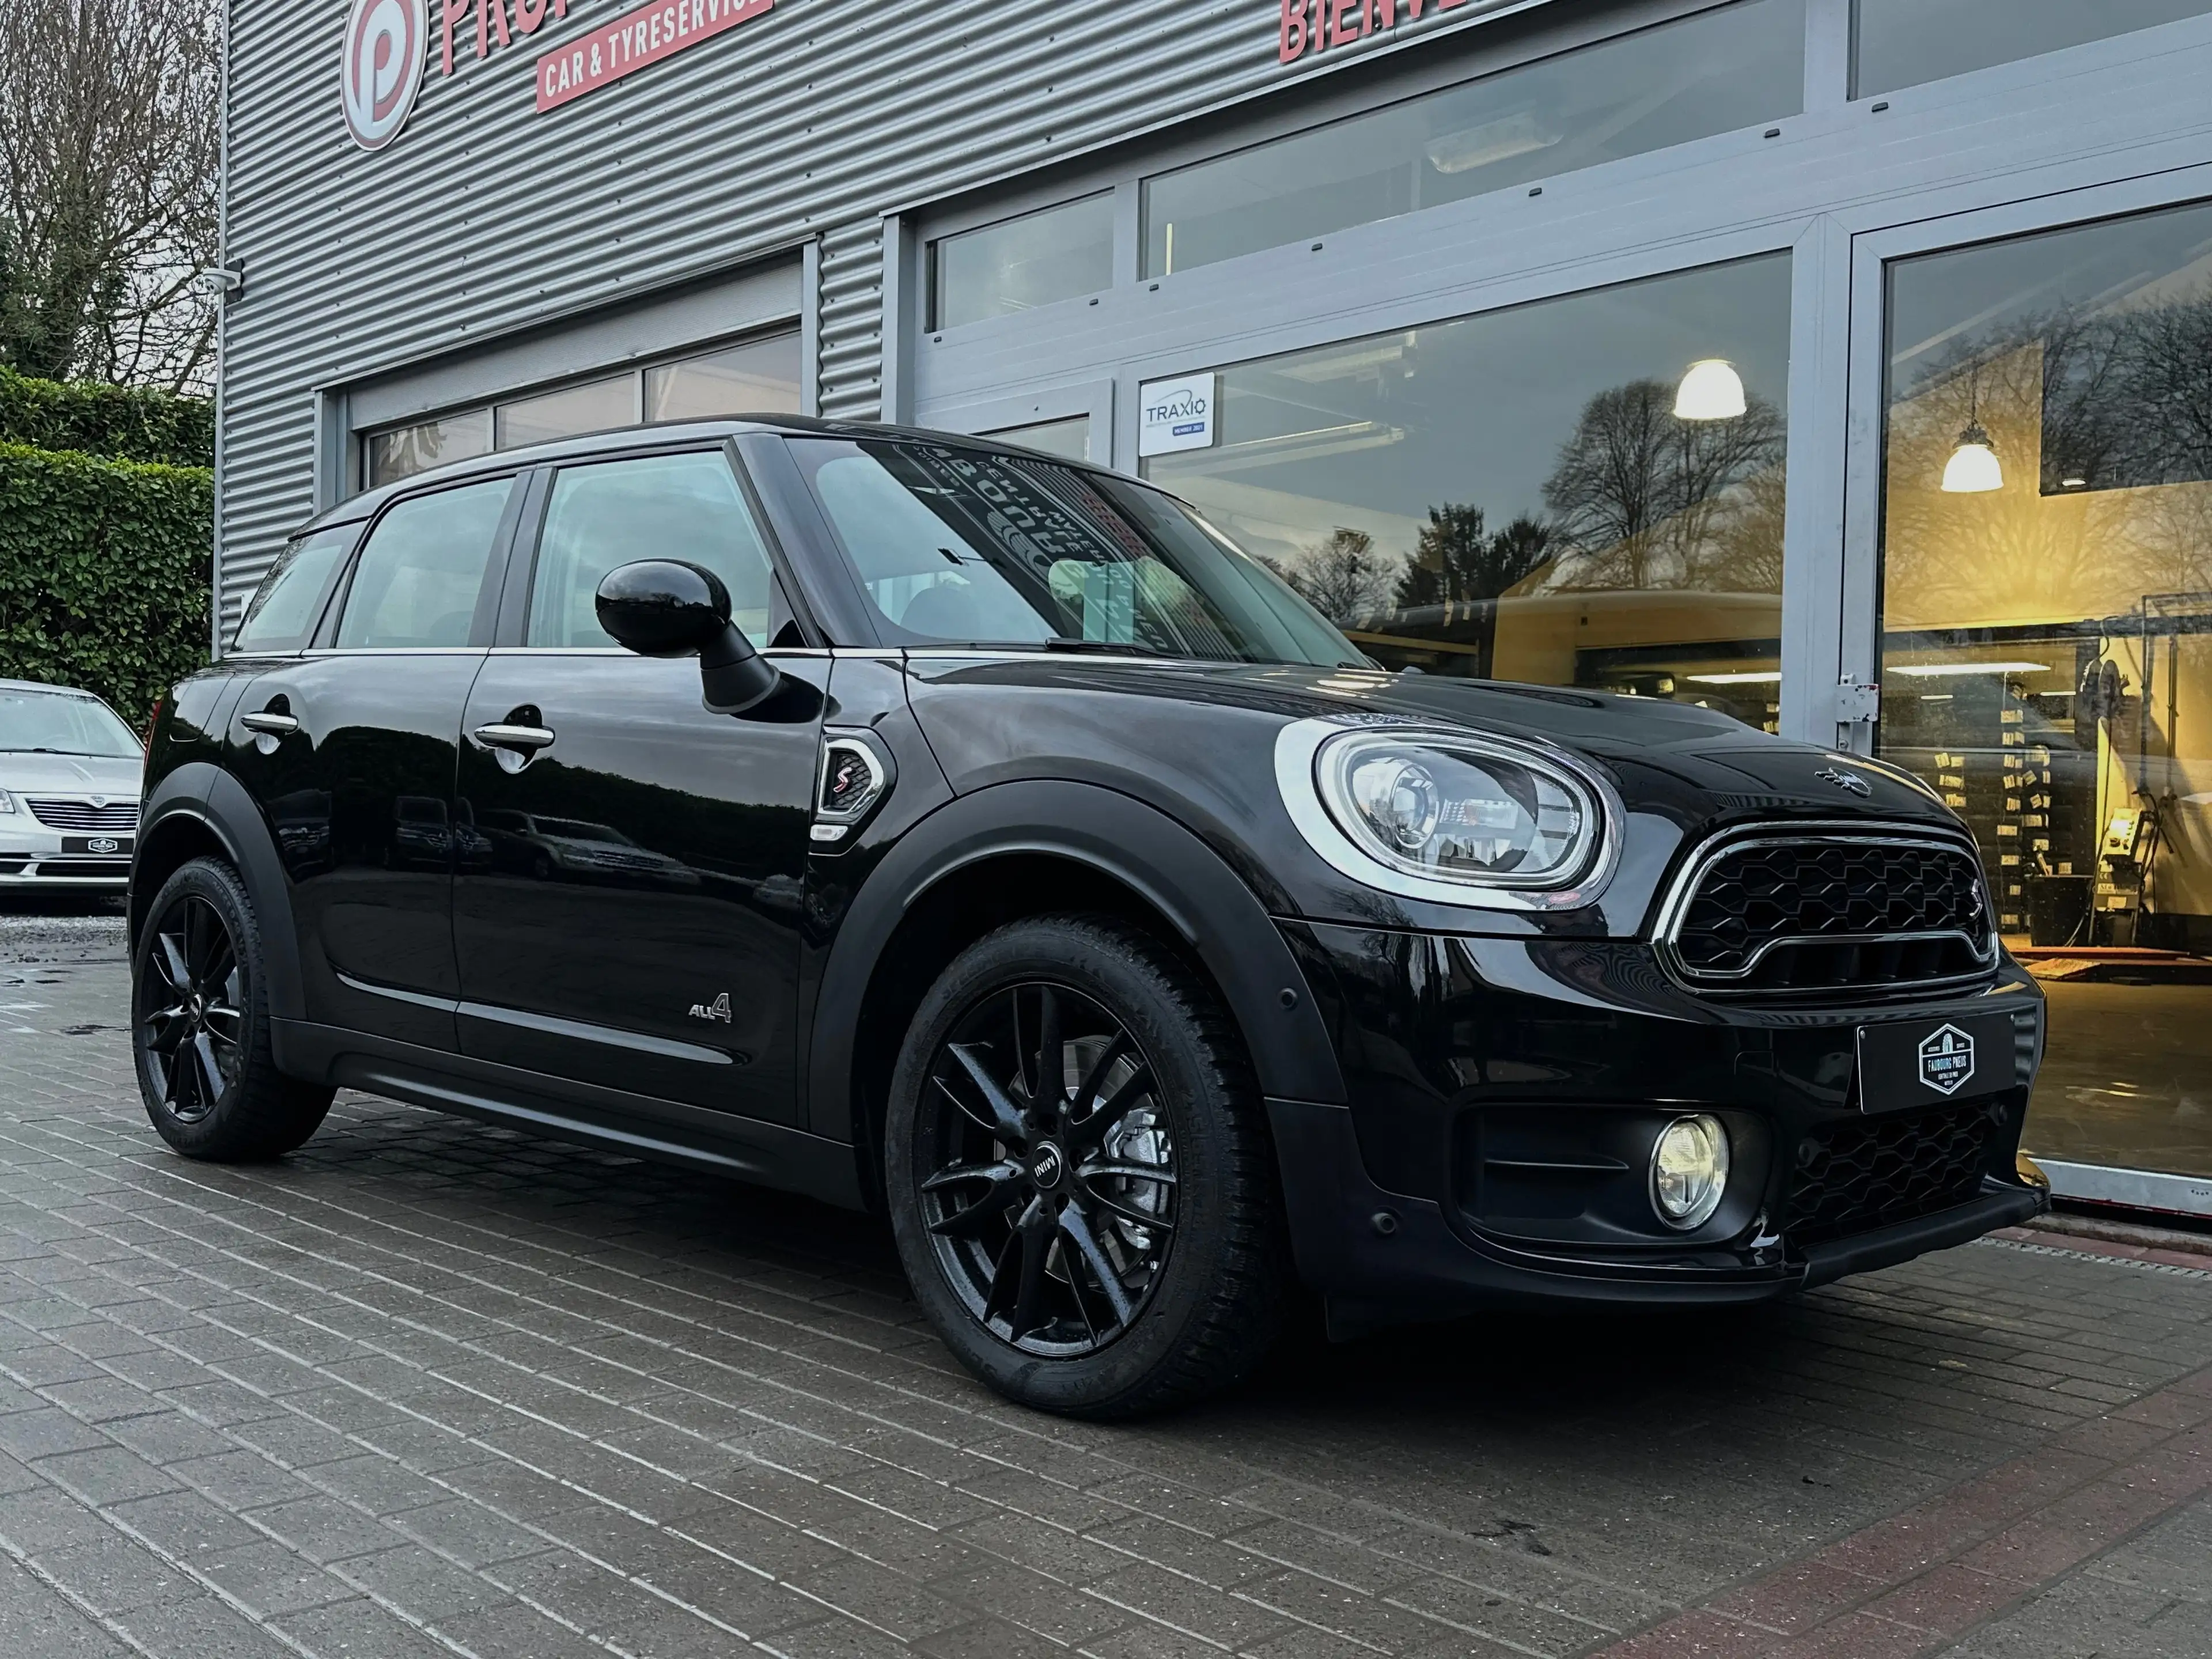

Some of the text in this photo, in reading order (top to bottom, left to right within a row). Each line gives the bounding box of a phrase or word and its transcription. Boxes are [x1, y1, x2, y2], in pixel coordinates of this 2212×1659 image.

[546, 0, 759, 97] CAR & TYRESERVI
[1146, 398, 1206, 422] TRAXIO
[688, 993, 732, 1024] ALL4
[1034, 1156, 1056, 1177] MINI
